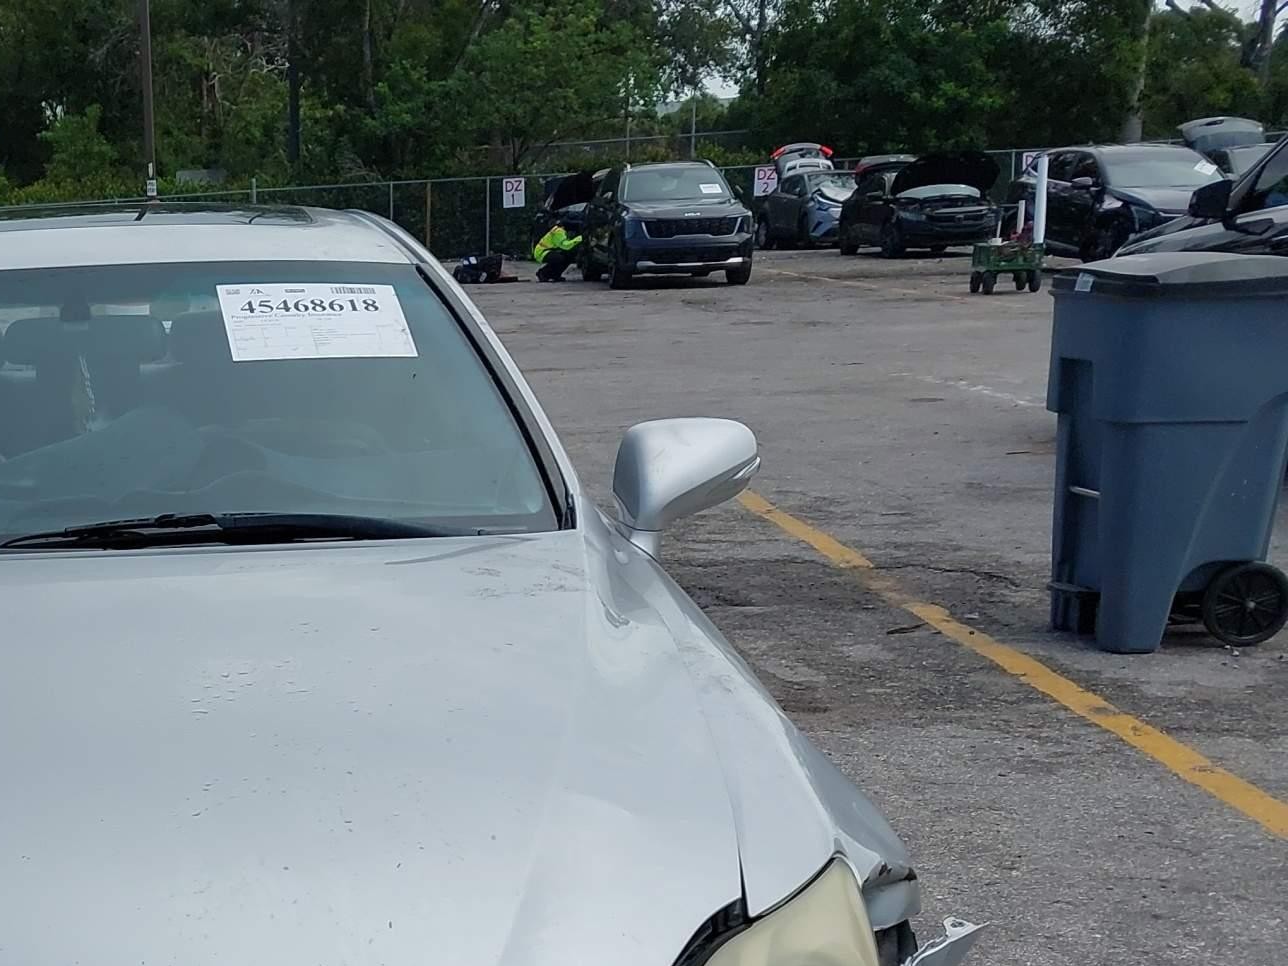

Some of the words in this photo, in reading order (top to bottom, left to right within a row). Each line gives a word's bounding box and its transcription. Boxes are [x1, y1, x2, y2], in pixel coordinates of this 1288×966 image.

[757, 169, 776, 181] DZ
[505, 180, 522, 192] DZ
[761, 182, 769, 194] 2
[240, 298, 380, 314] 45468618
